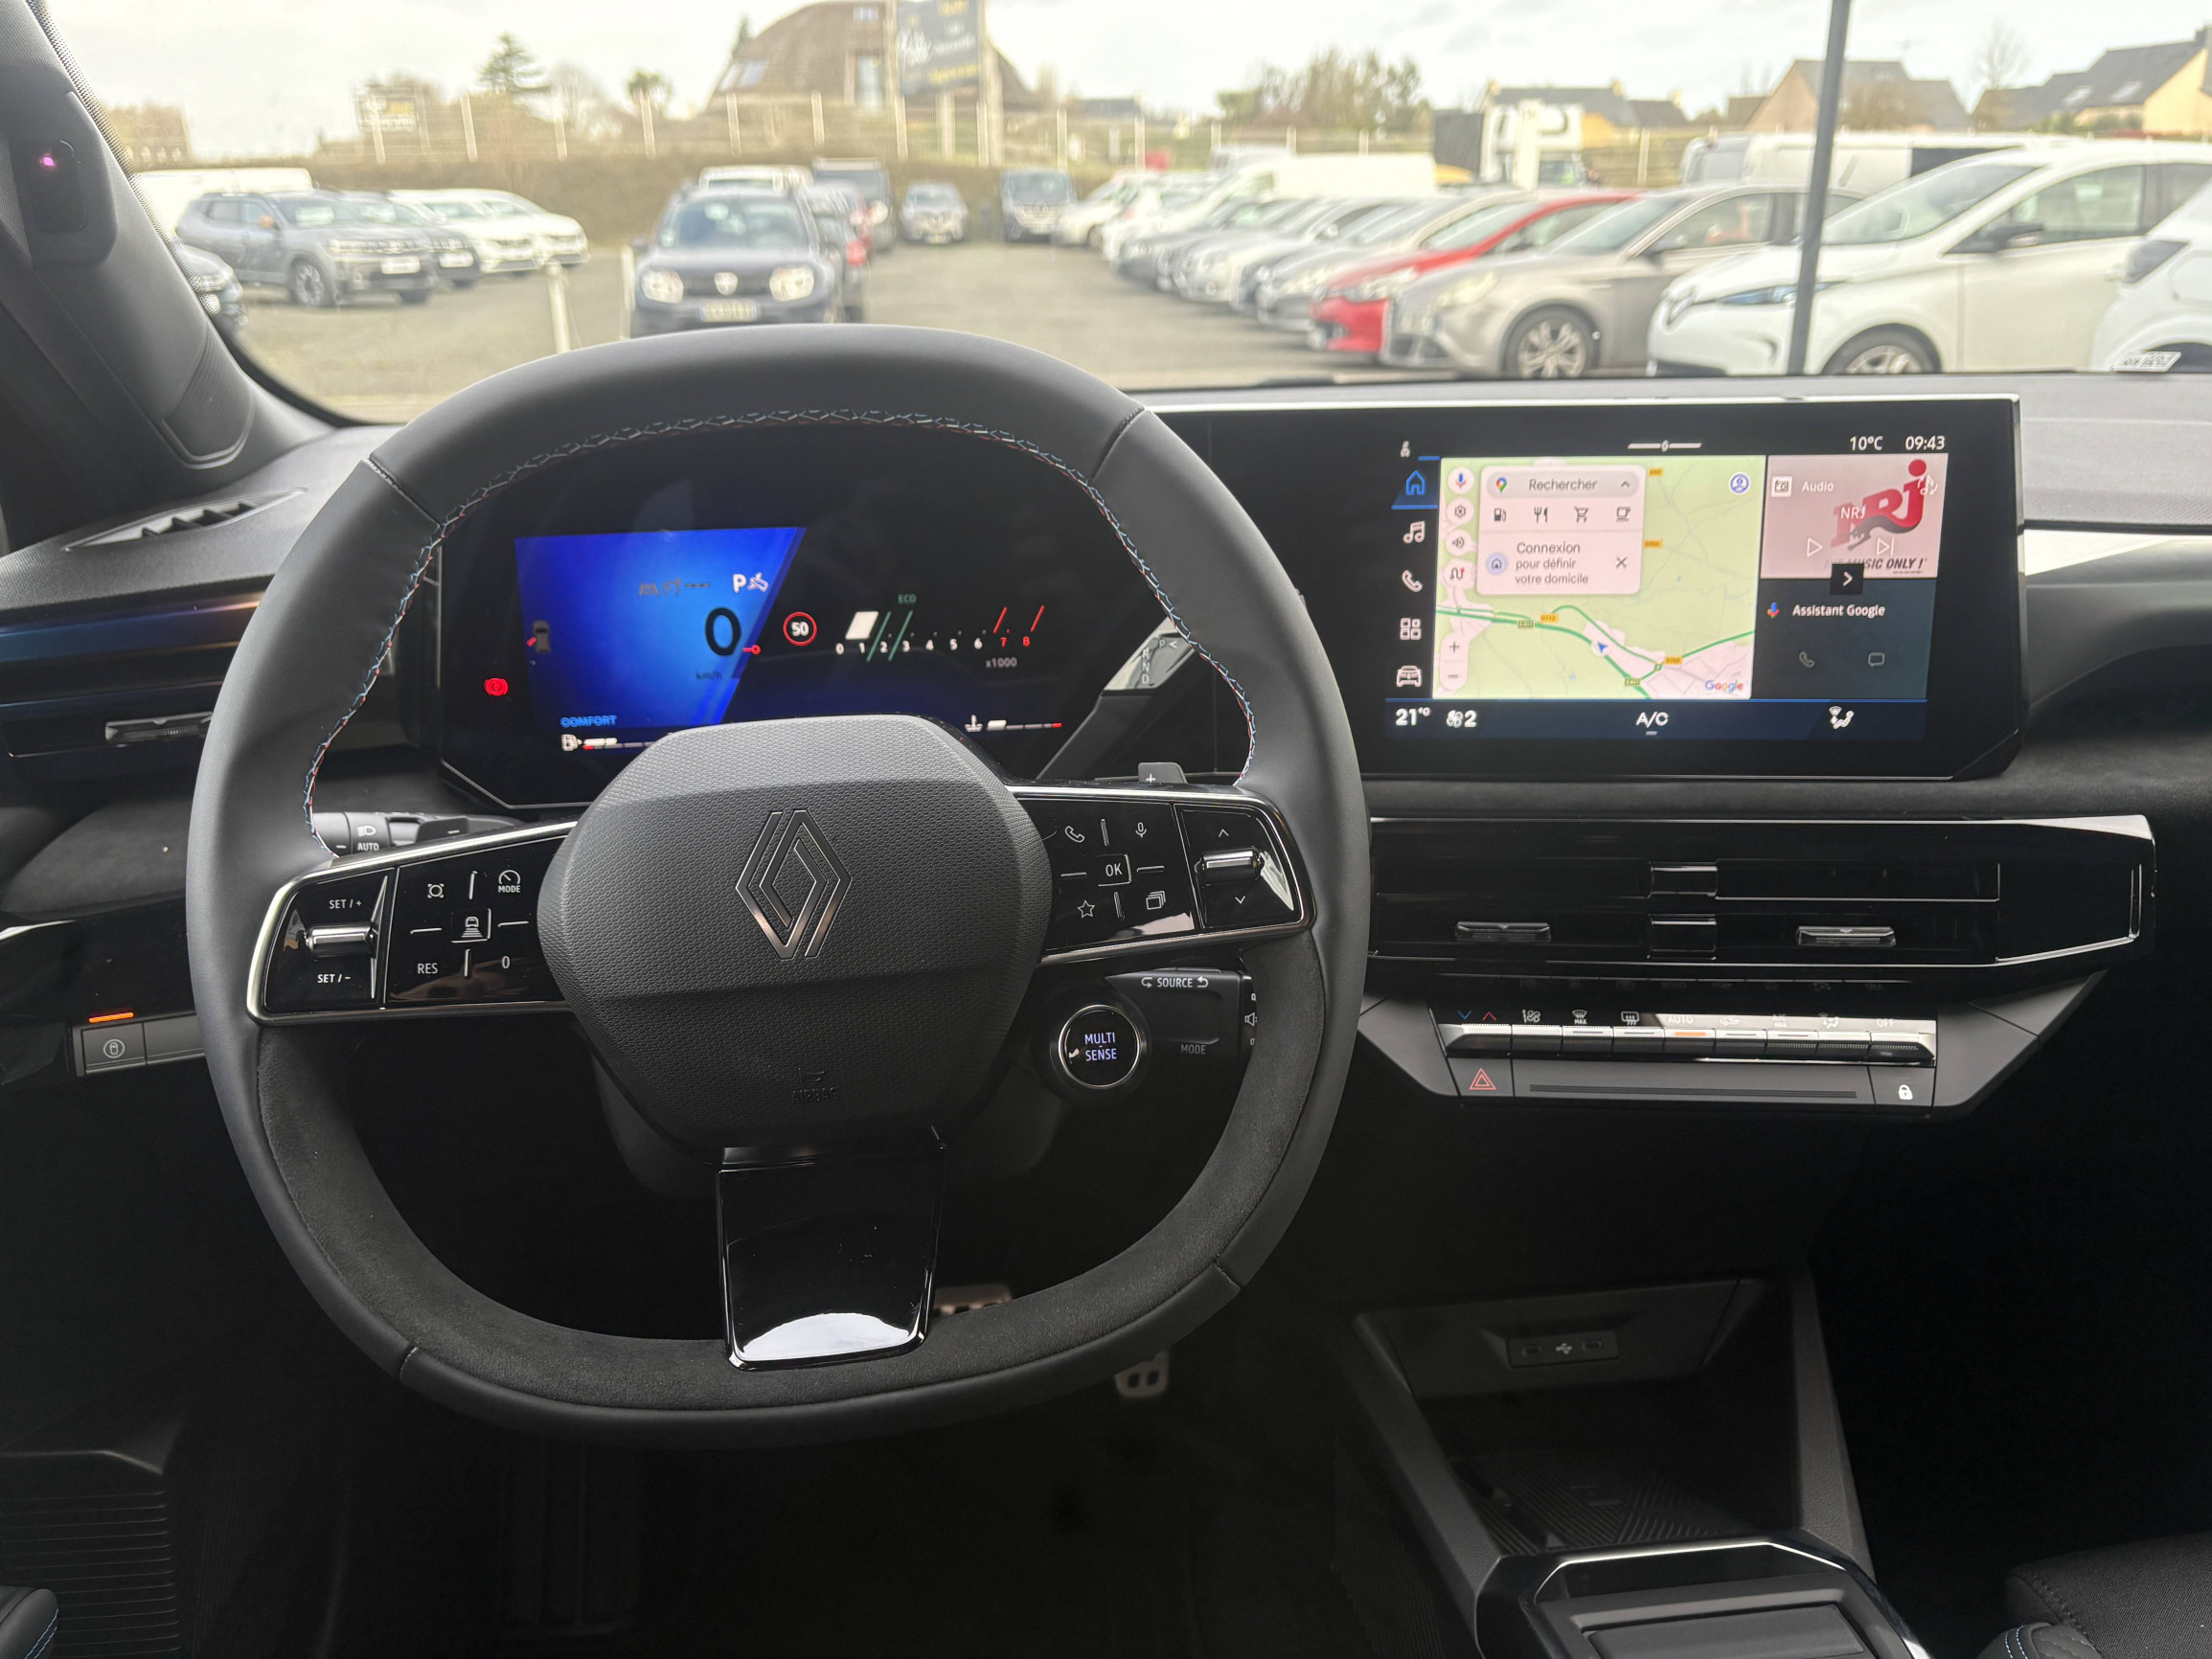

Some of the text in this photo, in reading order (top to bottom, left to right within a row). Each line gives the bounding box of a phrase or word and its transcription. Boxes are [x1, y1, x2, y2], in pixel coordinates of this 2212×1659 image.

[1904, 436, 1945, 450] 09:43
[1528, 479, 1597, 490] Rechercher
[1801, 481, 1834, 492] Audio
[1840, 505, 1867, 519] NRJ
[1516, 541, 1581, 554] Connexion
[1516, 557, 1576, 571] pour définir
[1885, 557, 1916, 569] ONLY
[732, 574, 747, 593] P
[1515, 573, 1589, 584] votre domicile
[898, 594, 917, 604] ECO
[1792, 604, 1885, 618] Assistant Google
[704, 607, 741, 656] 0
[790, 622, 810, 636] 50
[986, 657, 1017, 669] x1000
[1704, 679, 1744, 692] Google
[560, 715, 617, 728] COMFORT
[1635, 712, 1669, 727] A/C
[357, 842, 379, 852] AUTO
[1106, 862, 1123, 877] OK
[497, 885, 521, 894] MODE
[329, 898, 347, 909] SET
[417, 963, 439, 975] RES
[317, 973, 335, 984] SET
[1156, 977, 1194, 988] SOURCE
[1876, 1019, 1895, 1028] OFF
[1084, 1032, 1116, 1045] MULTI
[1084, 1048, 1117, 1061] SENSE
[1180, 1043, 1206, 1055] MODE
